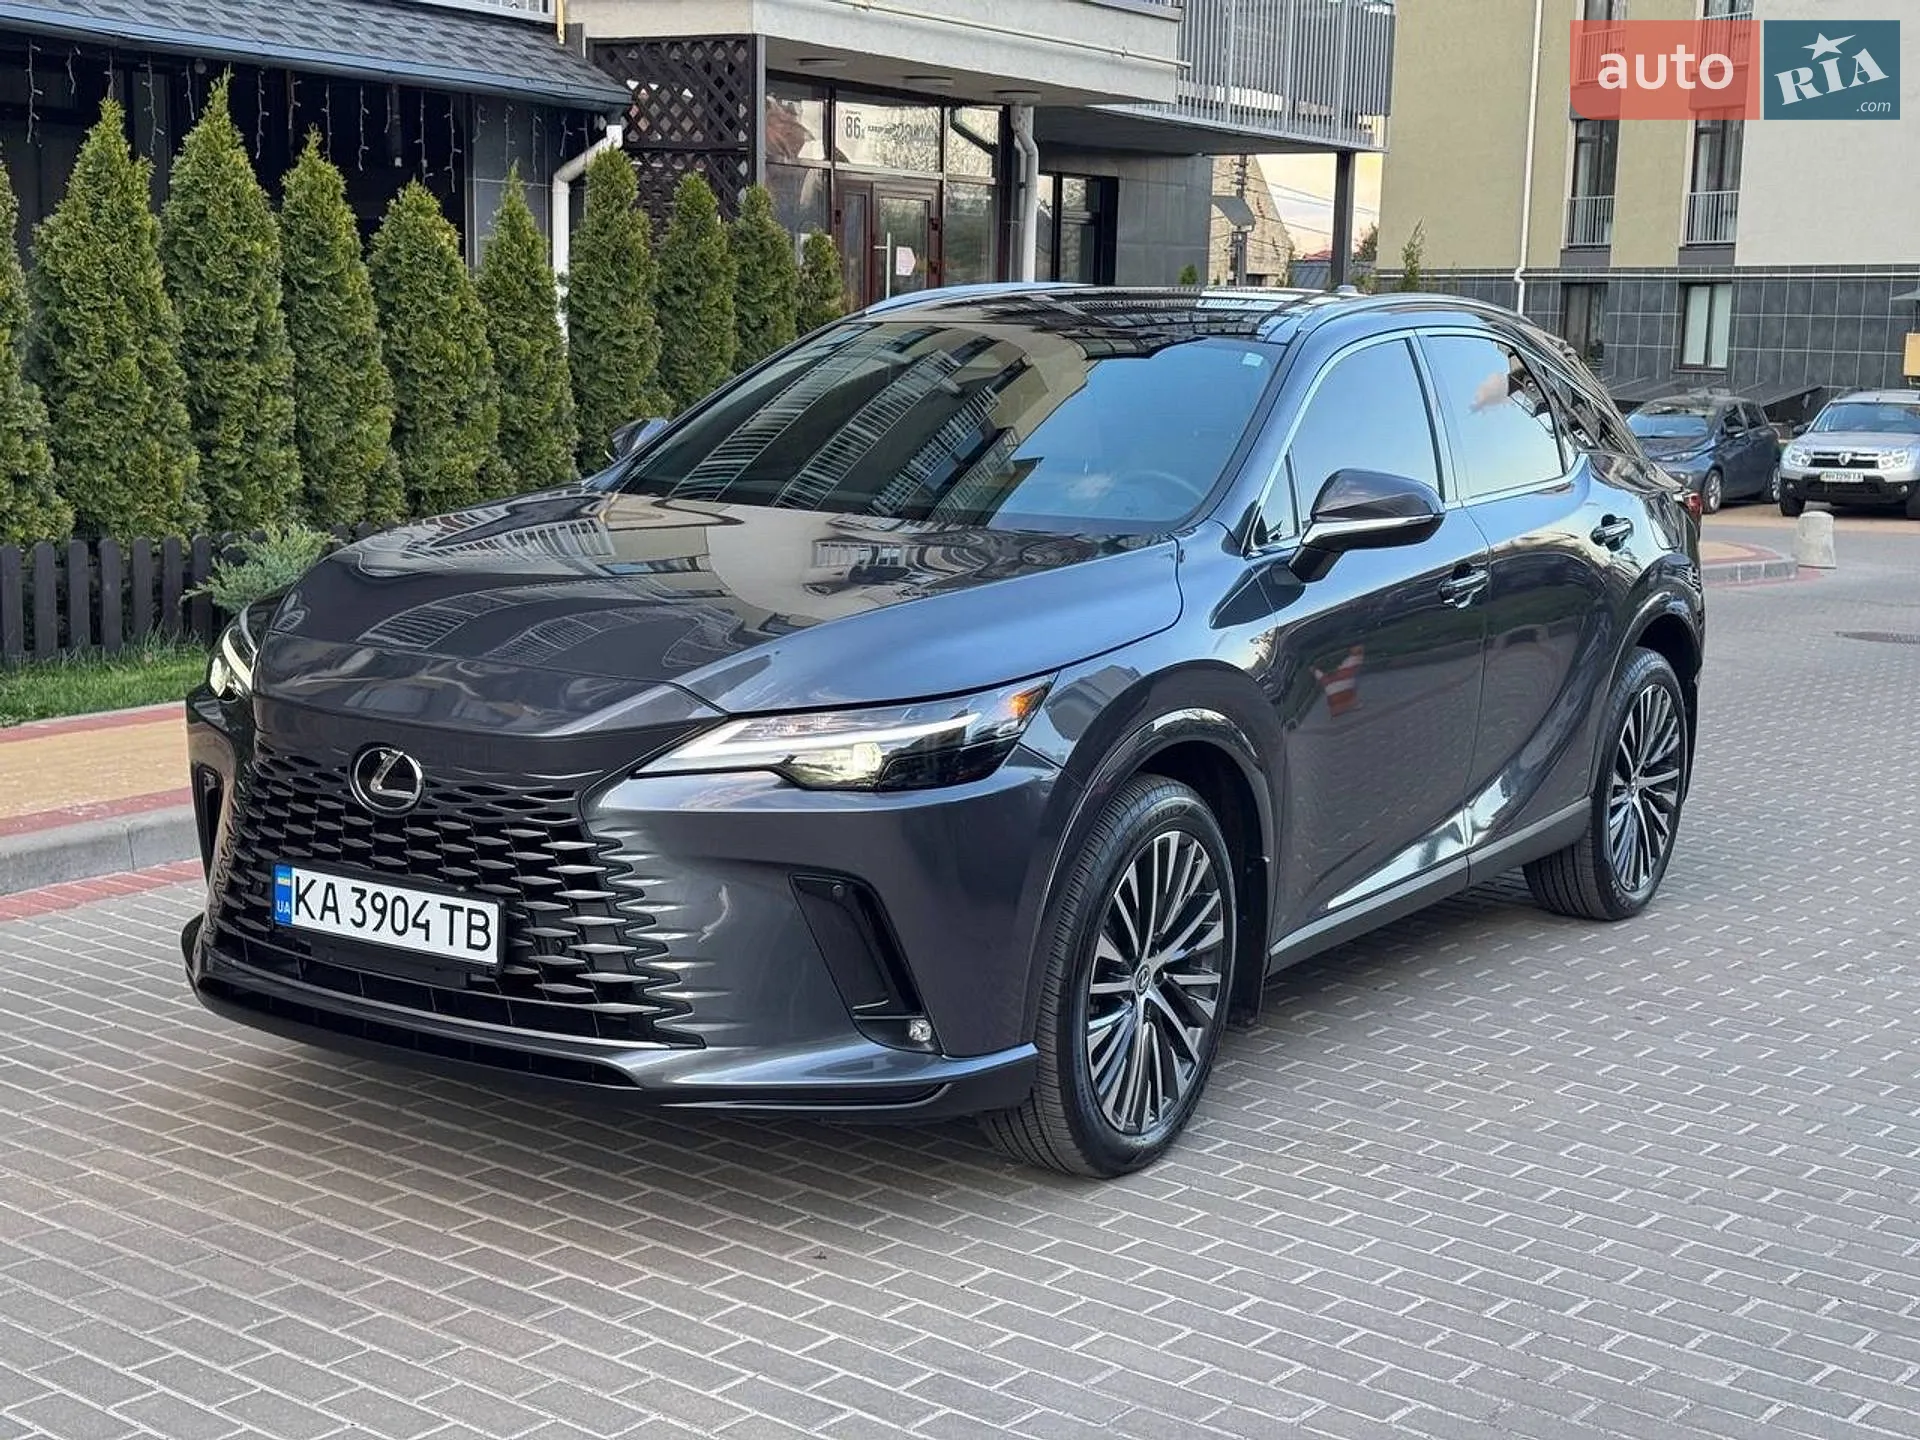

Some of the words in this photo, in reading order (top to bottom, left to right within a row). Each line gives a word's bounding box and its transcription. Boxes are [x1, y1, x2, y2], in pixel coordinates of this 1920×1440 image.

[277, 900, 291, 915] UA
[295, 875, 341, 925] KA
[350, 886, 431, 942] 3904
[439, 902, 492, 951] TB
